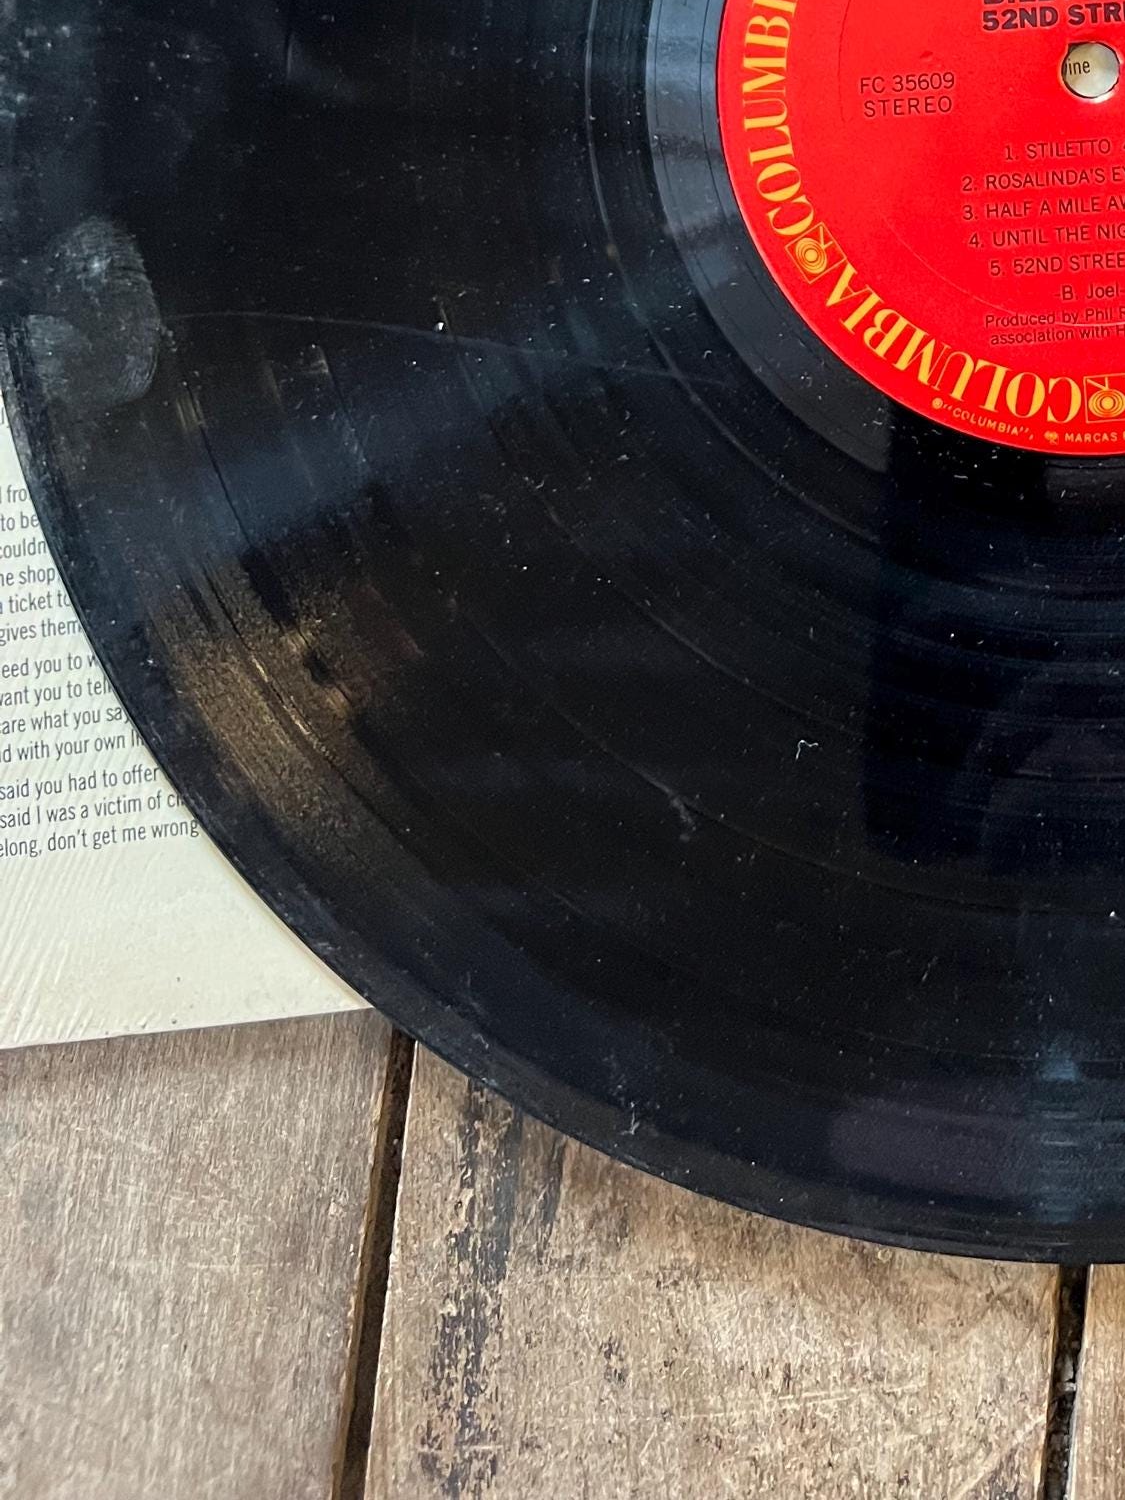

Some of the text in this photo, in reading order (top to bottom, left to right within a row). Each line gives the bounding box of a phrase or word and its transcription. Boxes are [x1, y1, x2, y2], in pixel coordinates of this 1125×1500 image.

[982, 6, 1059, 31] 52ND
[860, 72, 956, 94] FC 35609
[863, 96, 953, 118] STEREO
[1004, 145, 1019, 161] 1.
[1026, 138, 1111, 159] STILETTO
[962, 176, 977, 192] 2.
[985, 168, 1106, 190] ROSALINDA'S
[962, 205, 978, 221] 3.
[986, 201, 1031, 219] HALF
[1039, 200, 1052, 215] A
[1058, 198, 1101, 214] MILE
[969, 232, 984, 248] 4.
[993, 229, 1048, 247] UNTIL
[1055, 226, 1089, 242] THE
[991, 260, 1005, 276] 5.
[1013, 257, 1063, 275] 52ND
[985, 313, 1055, 328] Produced
[1062, 311, 1078, 324] by
[1086, 308, 1112, 321] Phil
[822, 251, 1081, 425] COLUMBIA
[991, 328, 1074, 345] association
[1080, 325, 1109, 339] with
[1064, 432, 1118, 443] MARCAS
[0, 764, 160, 801] said you had to offer
[0, 790, 162, 829] said I was a victim of
[48, 829, 88, 851] don't
[93, 826, 117, 849] get
[123, 826, 146, 842] me
[151, 819, 199, 838] wrong
